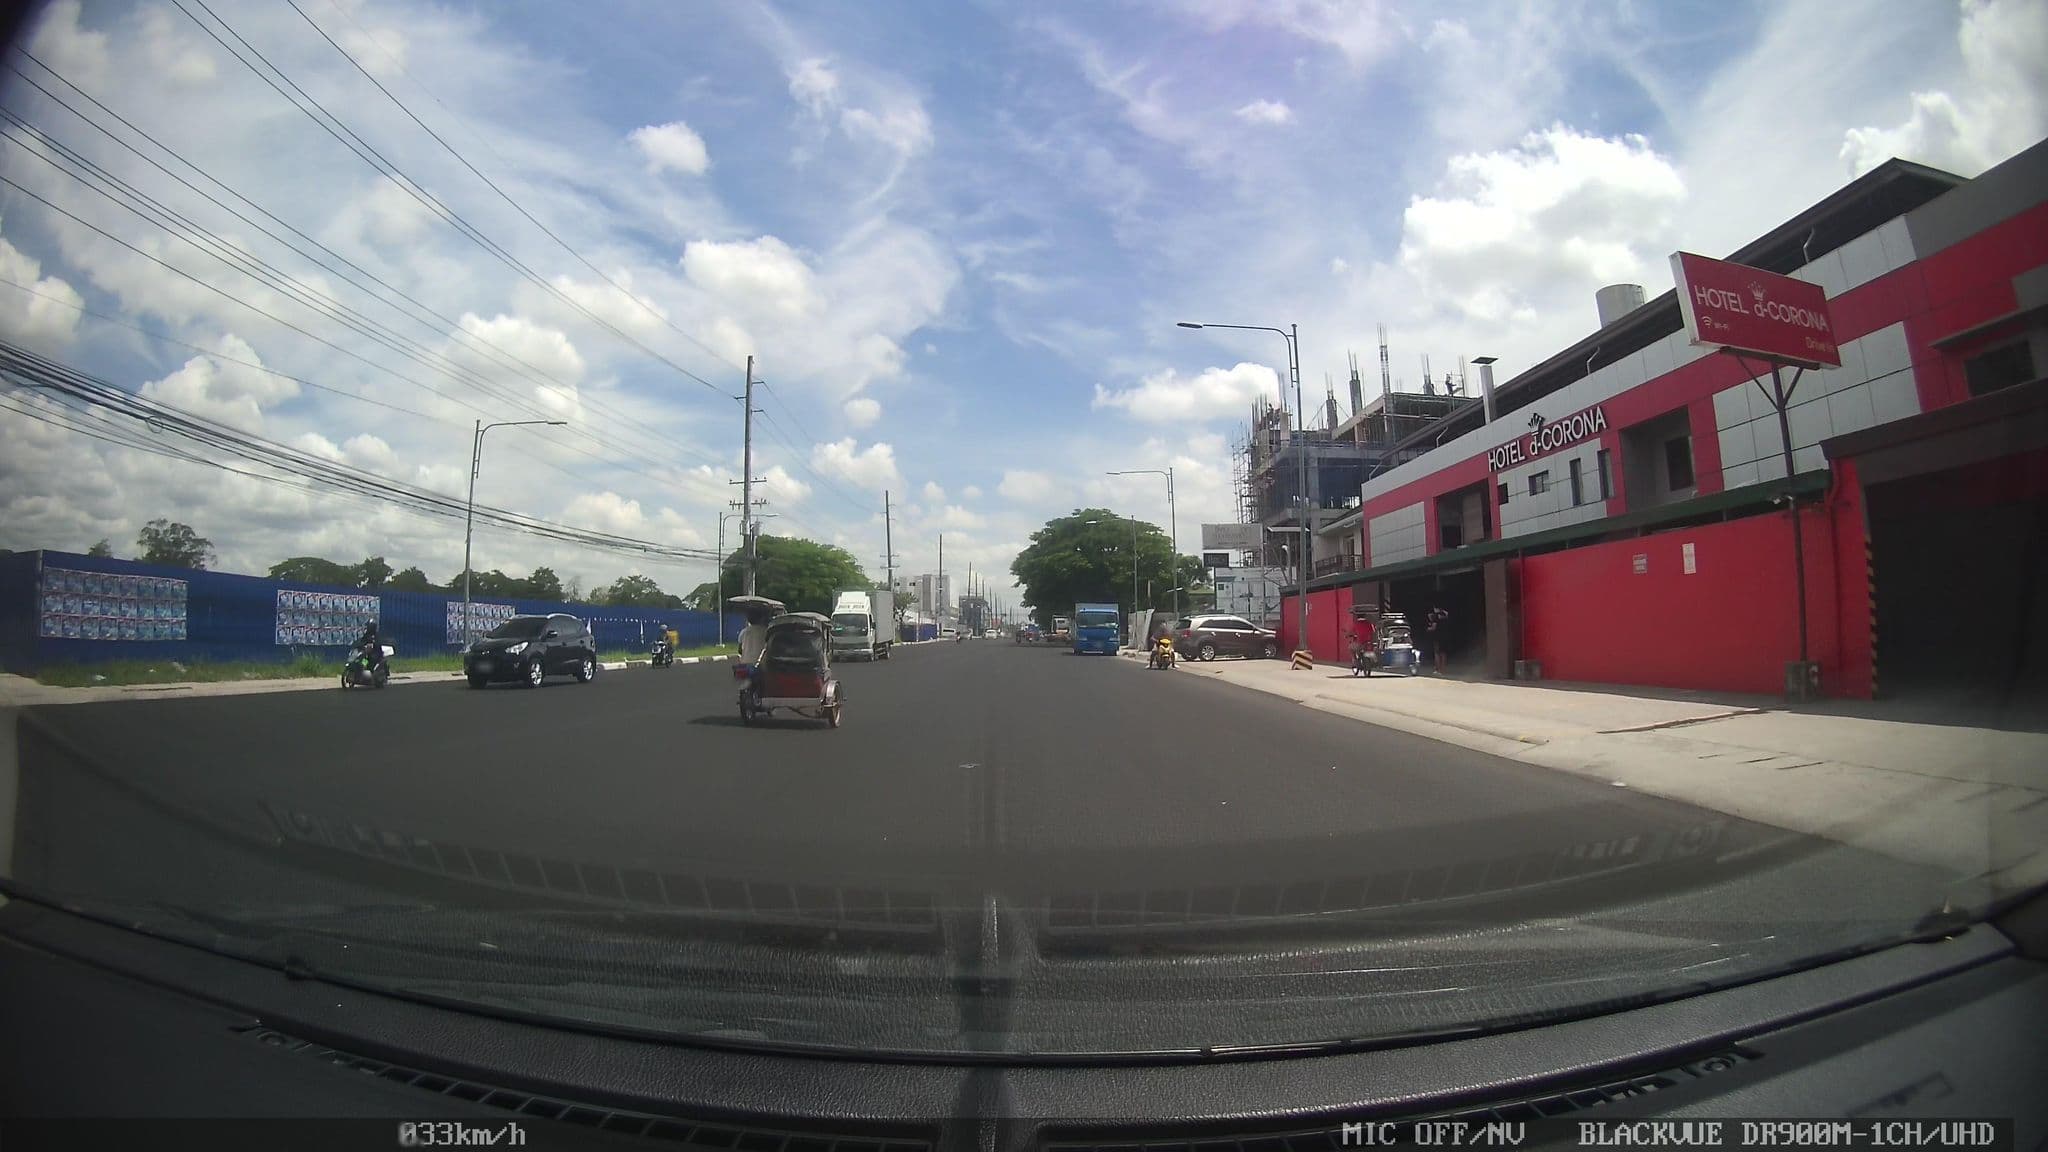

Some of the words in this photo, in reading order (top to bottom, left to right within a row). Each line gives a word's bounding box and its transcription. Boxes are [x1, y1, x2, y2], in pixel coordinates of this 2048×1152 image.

[1694, 285, 1749, 314] HOTEL
[1754, 300, 1829, 332] d-CORONA
[1487, 440, 1525, 472] HOTEL
[1530, 405, 1607, 455] d-CORONA
